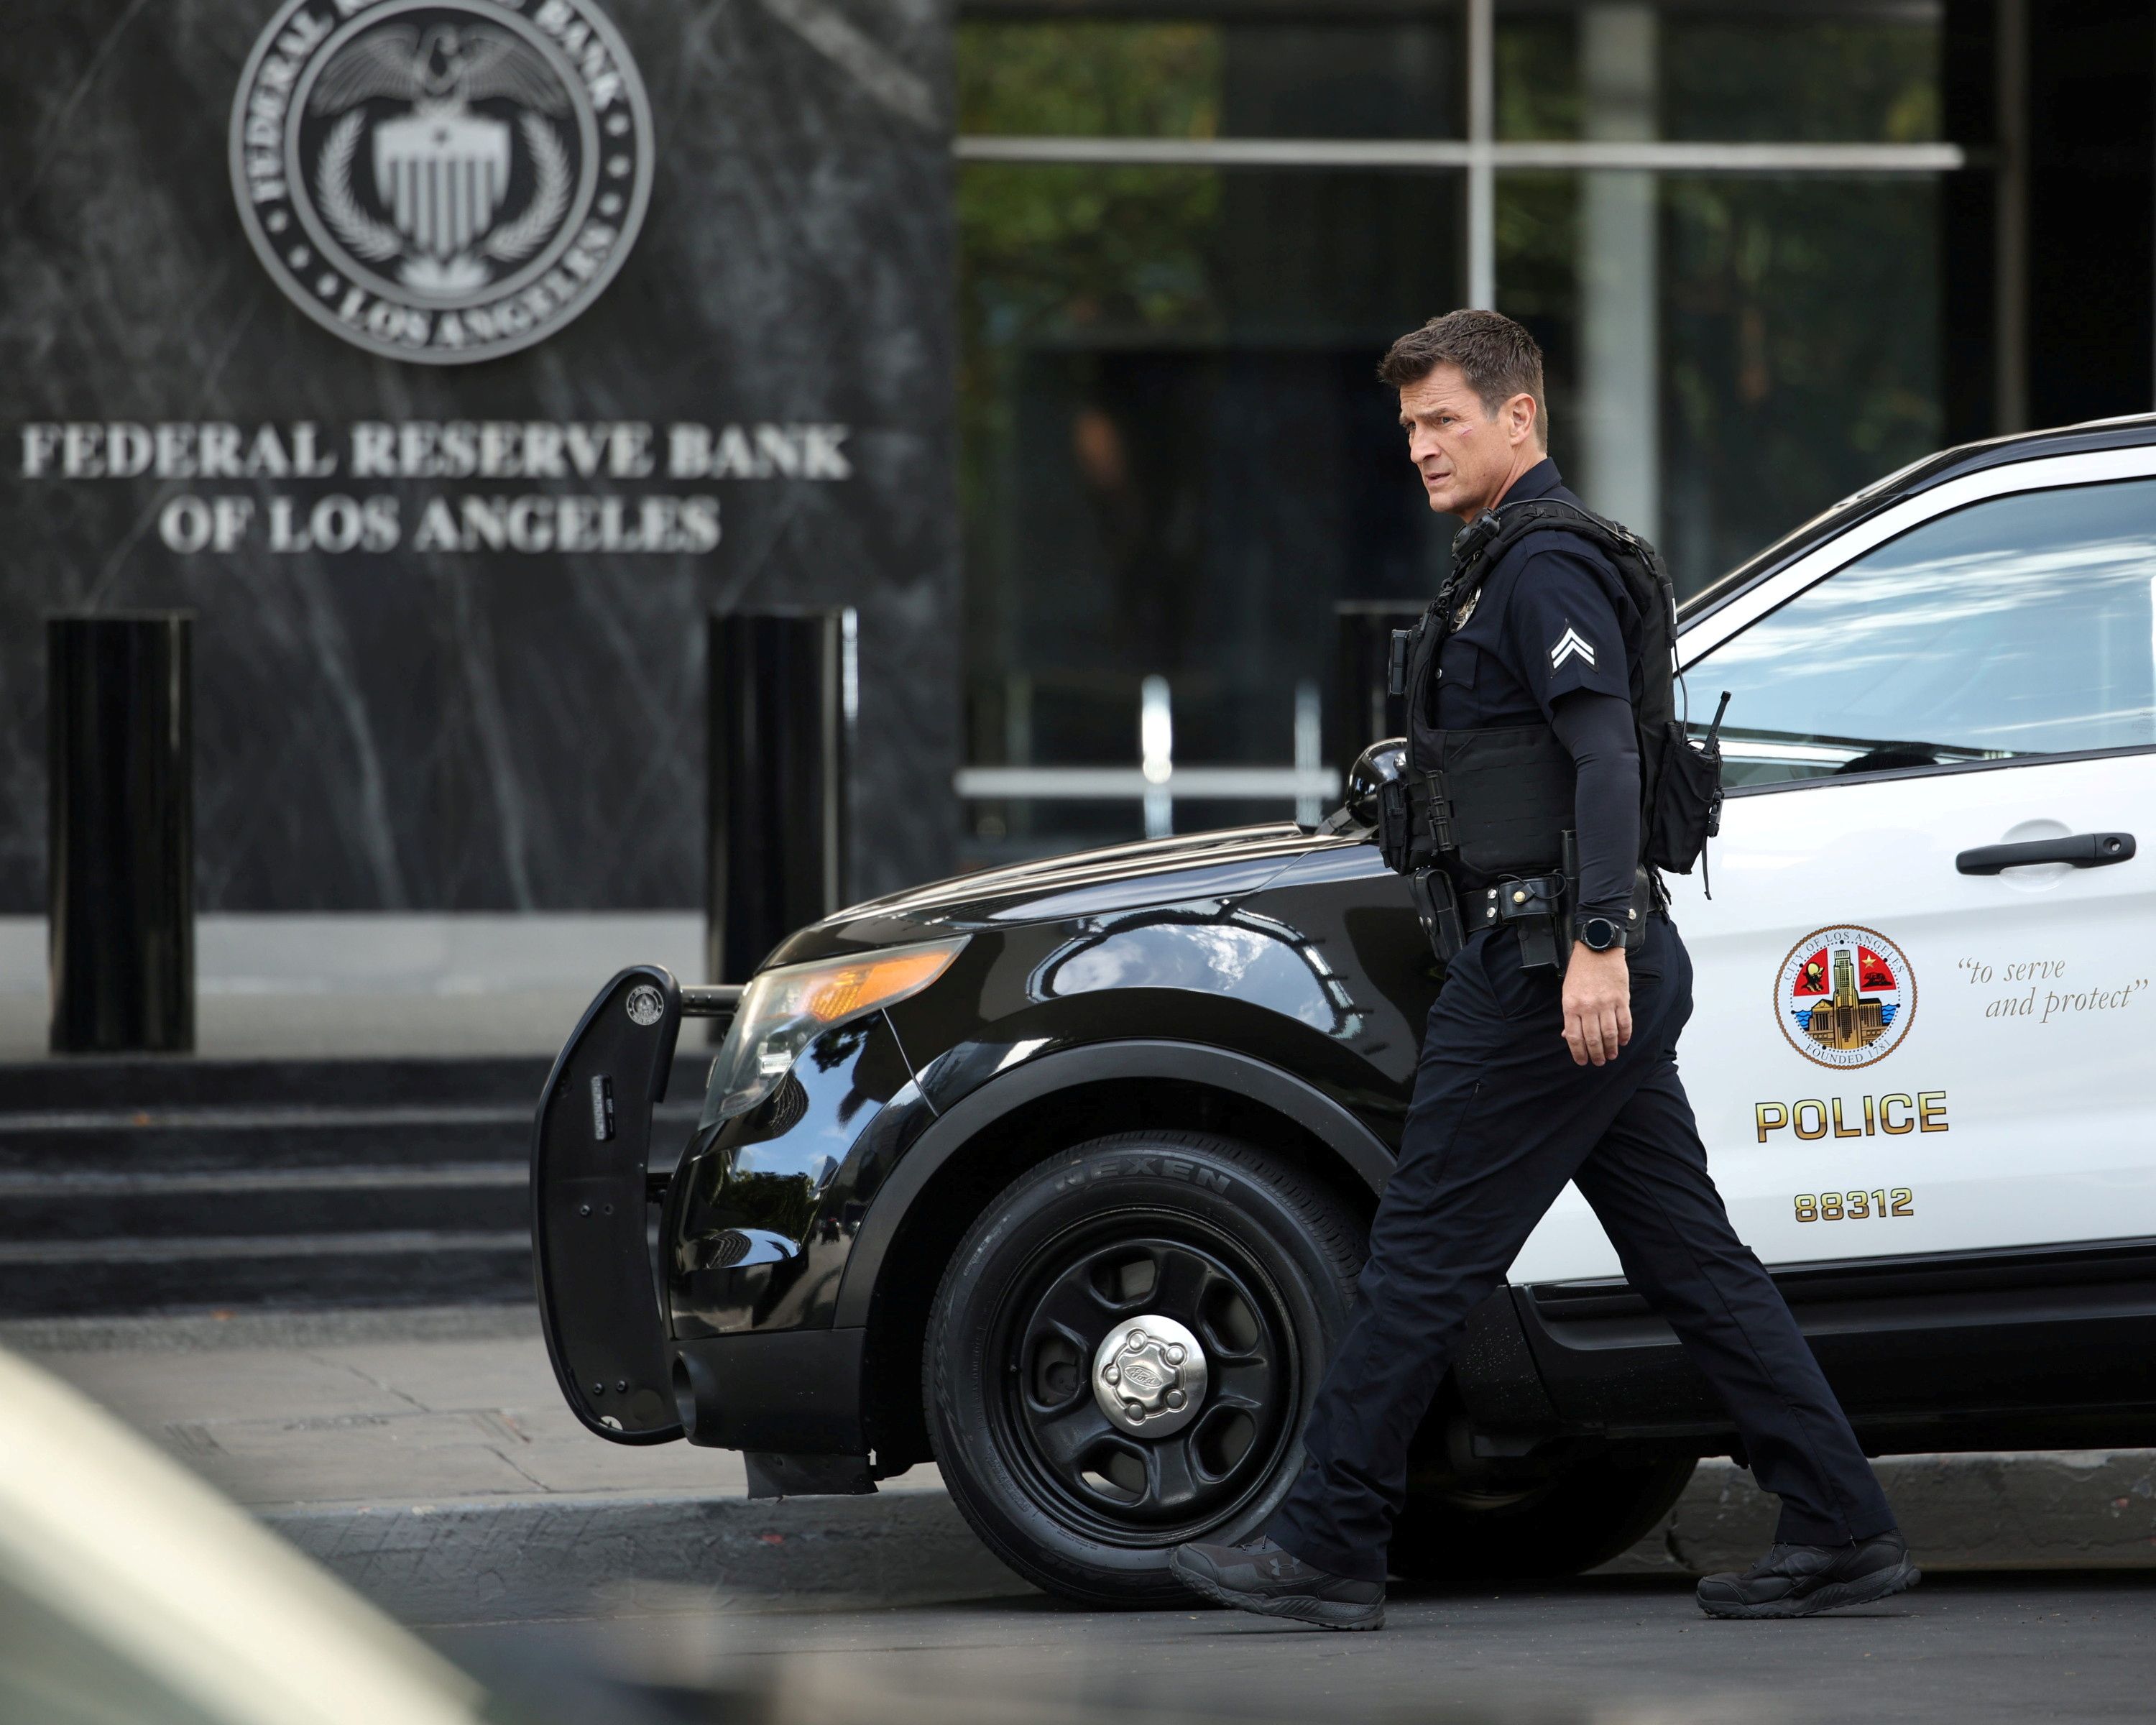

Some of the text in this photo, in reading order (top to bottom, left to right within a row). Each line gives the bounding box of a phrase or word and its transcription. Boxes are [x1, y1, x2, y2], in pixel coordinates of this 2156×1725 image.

[244, 9, 336, 203] FEDERAL
[339, 223, 617, 350] LOS ANGELES
[21, 419, 853, 482] FEDERAL RESERVE BANK
[159, 493, 722, 555] OF LOS ANGELES
[1784, 952, 1804, 980] CITY
[1806, 939, 1820, 951] OF
[1855, 932, 1904, 972] ANGELES
[1958, 957, 2065, 984] “to serve
[1985, 979, 2148, 1024] and protect”
[1805, 1039, 1892, 1064] FOUNDED 1781
[1755, 1090, 1948, 1143] POLICE
[1054, 1157, 1231, 1195] NEXEN
[1794, 1187, 1914, 1222] 88312
[1130, 1368, 1157, 1384] Ford
